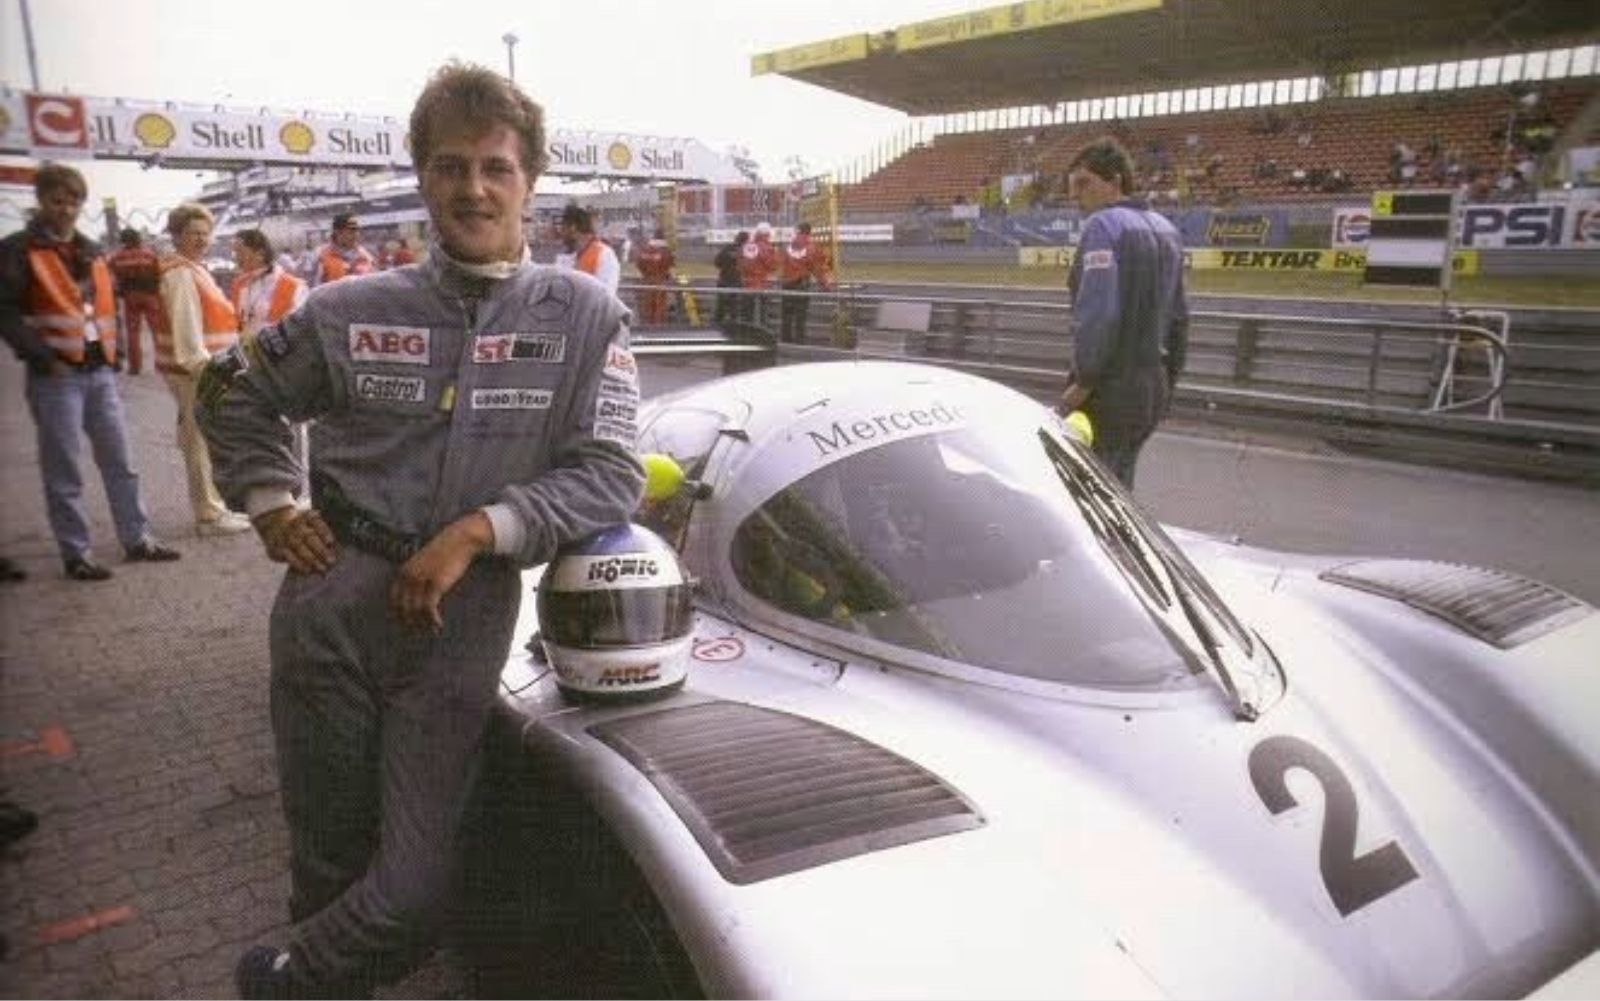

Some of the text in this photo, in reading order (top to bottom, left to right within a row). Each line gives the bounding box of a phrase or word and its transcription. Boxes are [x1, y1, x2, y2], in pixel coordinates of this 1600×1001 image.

[191, 121, 266, 150] Shell
[327, 128, 392, 156] Shell
[549, 143, 598, 165] Shell
[641, 148, 684, 170] Shell
[1461, 206, 1565, 247] PSI
[1220, 251, 1368, 268] TEXTAR Bre
[353, 331, 426, 356] AEG
[361, 376, 421, 400] Castrol
[1247, 735, 1420, 918] 2
